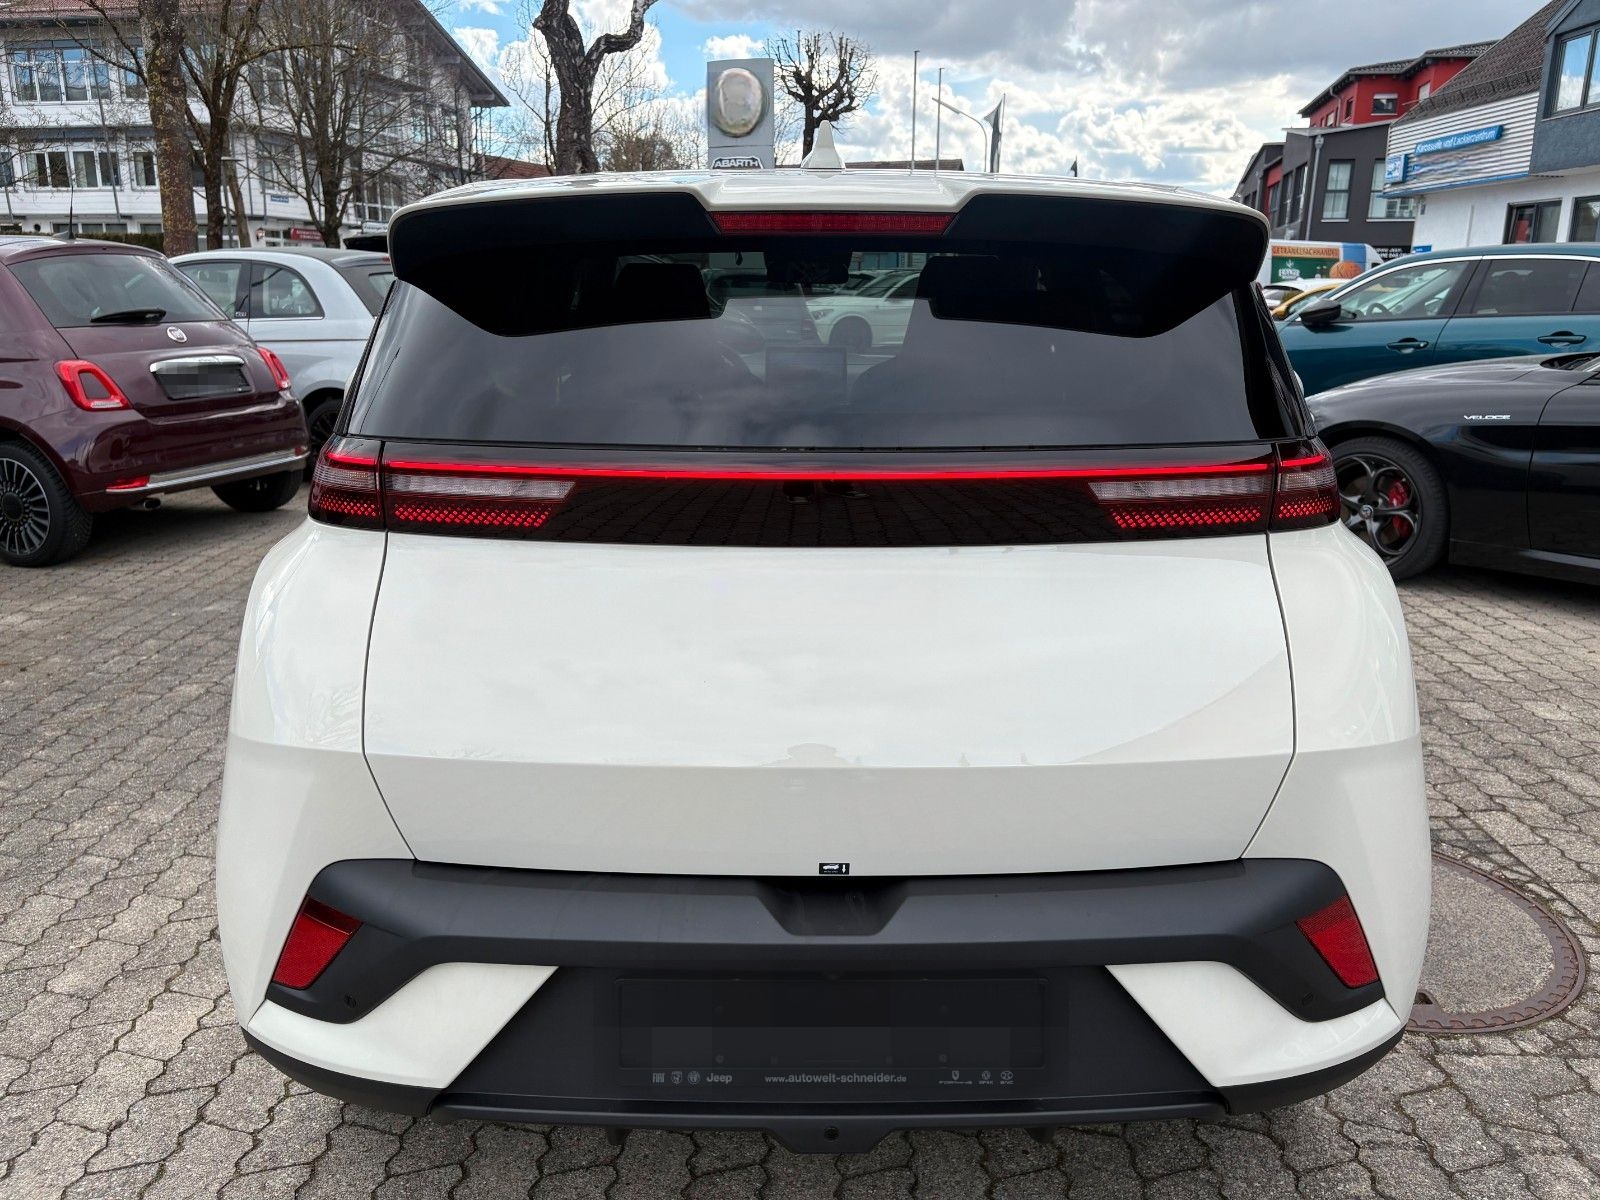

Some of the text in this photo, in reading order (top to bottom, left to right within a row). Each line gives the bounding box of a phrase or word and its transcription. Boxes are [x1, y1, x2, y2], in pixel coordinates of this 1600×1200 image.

[714, 159, 758, 168] ABARTH
[706, 1072, 733, 1084] Jeep
[764, 1072, 907, 1083] www.autowelt-schneider.de
